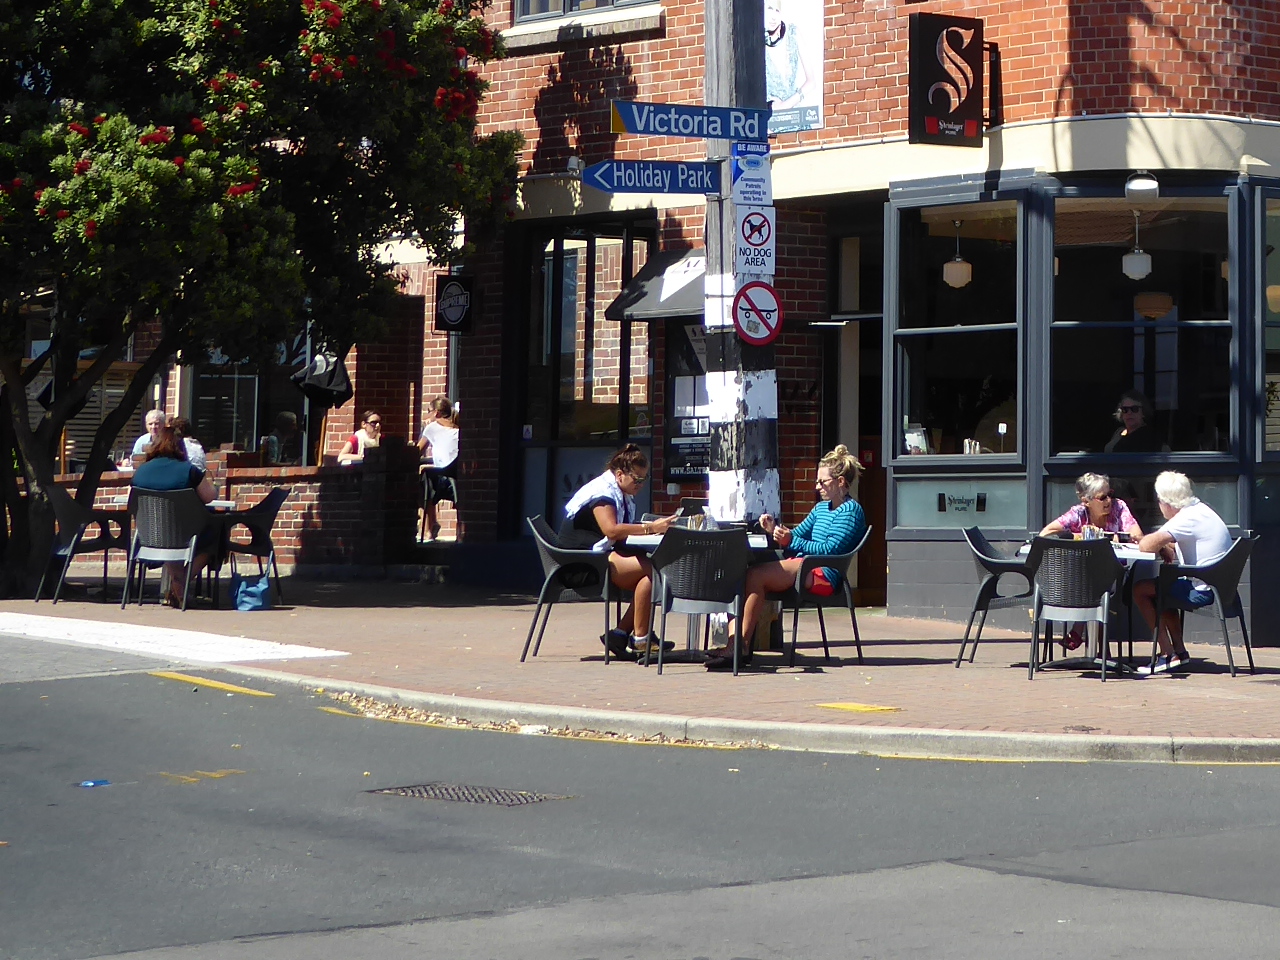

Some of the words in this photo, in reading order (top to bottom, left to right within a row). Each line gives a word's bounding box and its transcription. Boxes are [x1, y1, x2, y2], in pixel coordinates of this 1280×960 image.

[631, 104, 722, 136] Victoria
[729, 111, 759, 138] Rd
[737, 143, 747, 151] BE
[747, 143, 768, 152] AWARE
[613, 162, 671, 192] Holiday
[677, 163, 713, 189] Park
[739, 247, 752, 257] NO
[753, 248, 772, 257] DOG
[744, 257, 767, 267] AREA
